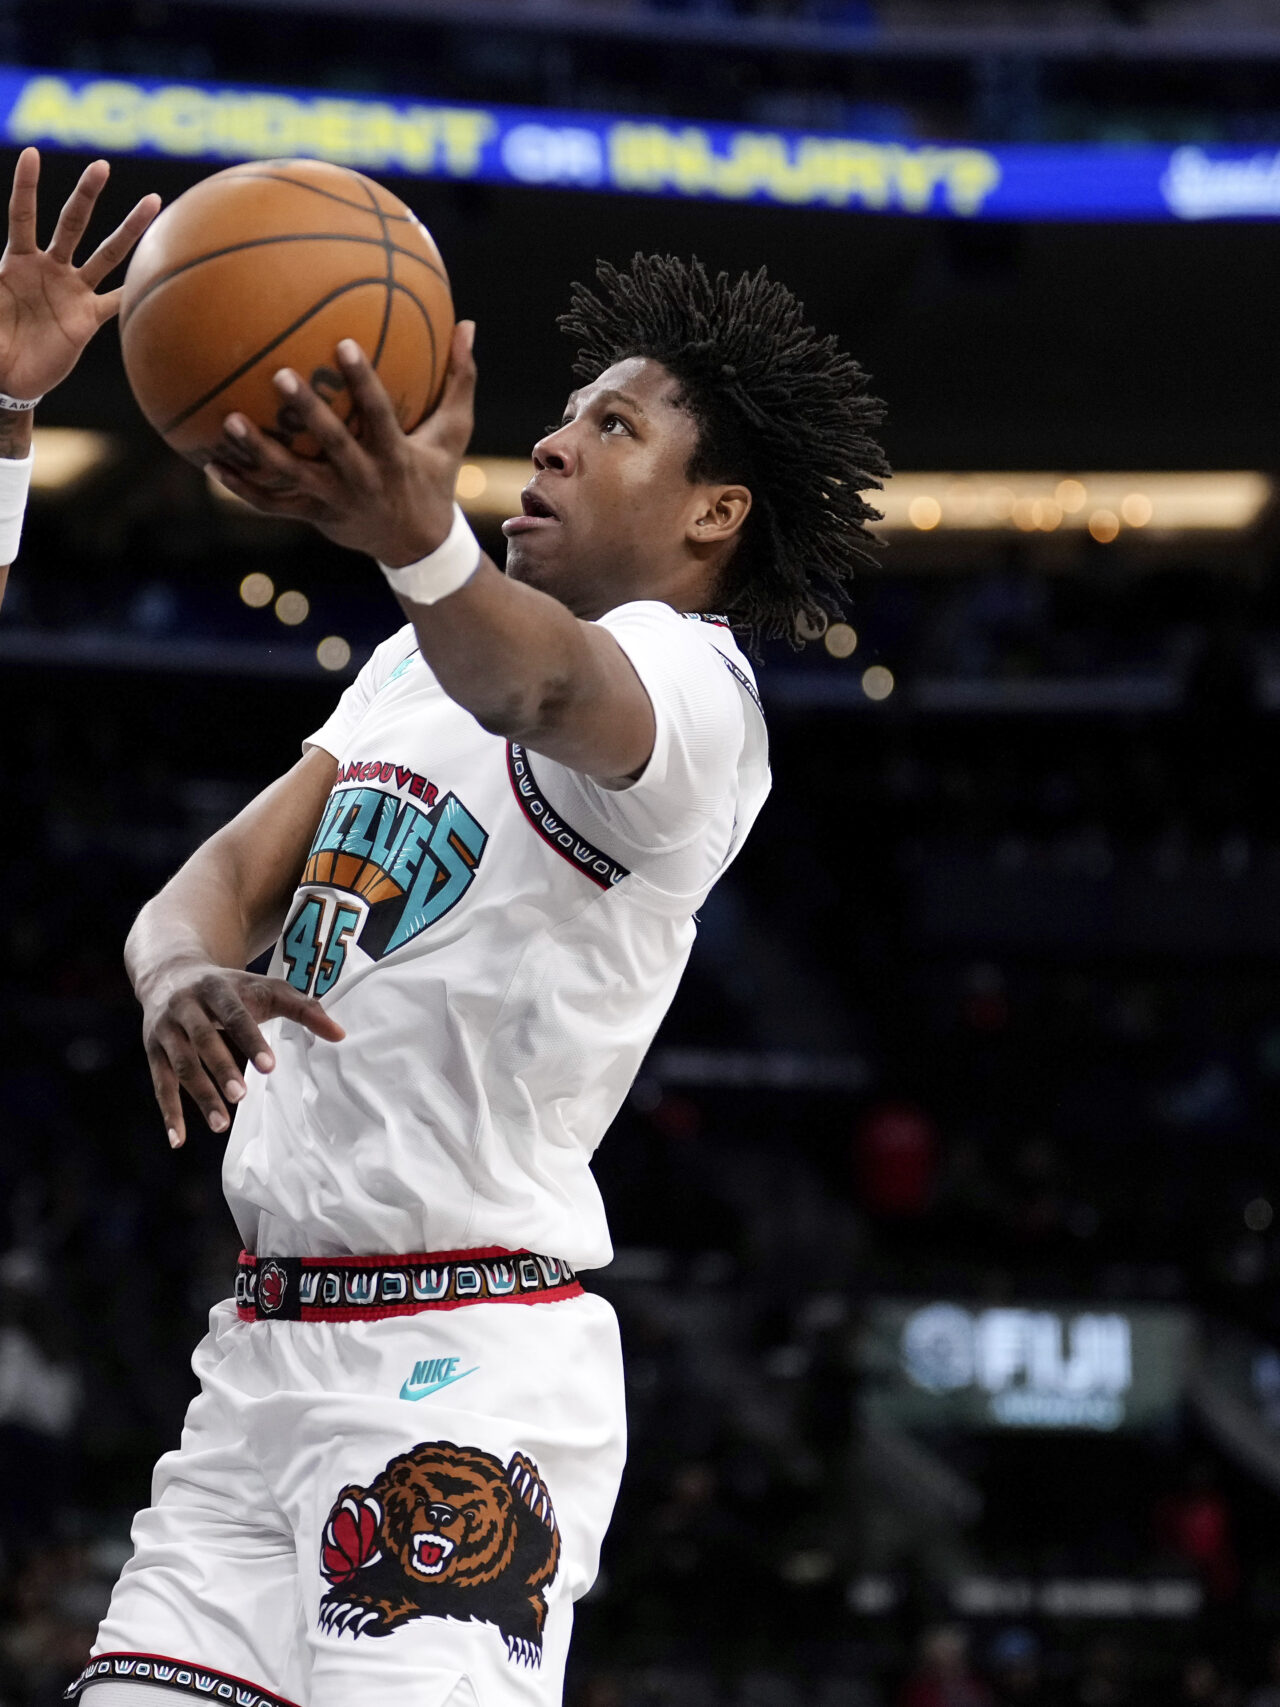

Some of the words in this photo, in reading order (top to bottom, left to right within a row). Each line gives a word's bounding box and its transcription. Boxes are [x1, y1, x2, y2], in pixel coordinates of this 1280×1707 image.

[10, 77, 494, 176] ACCIDENT
[502, 124, 602, 187] OR
[608, 121, 1001, 217] INJURY?
[334, 760, 439, 808] ANCOUVER
[283, 894, 362, 999] 45
[409, 1357, 461, 1385] NIKE
